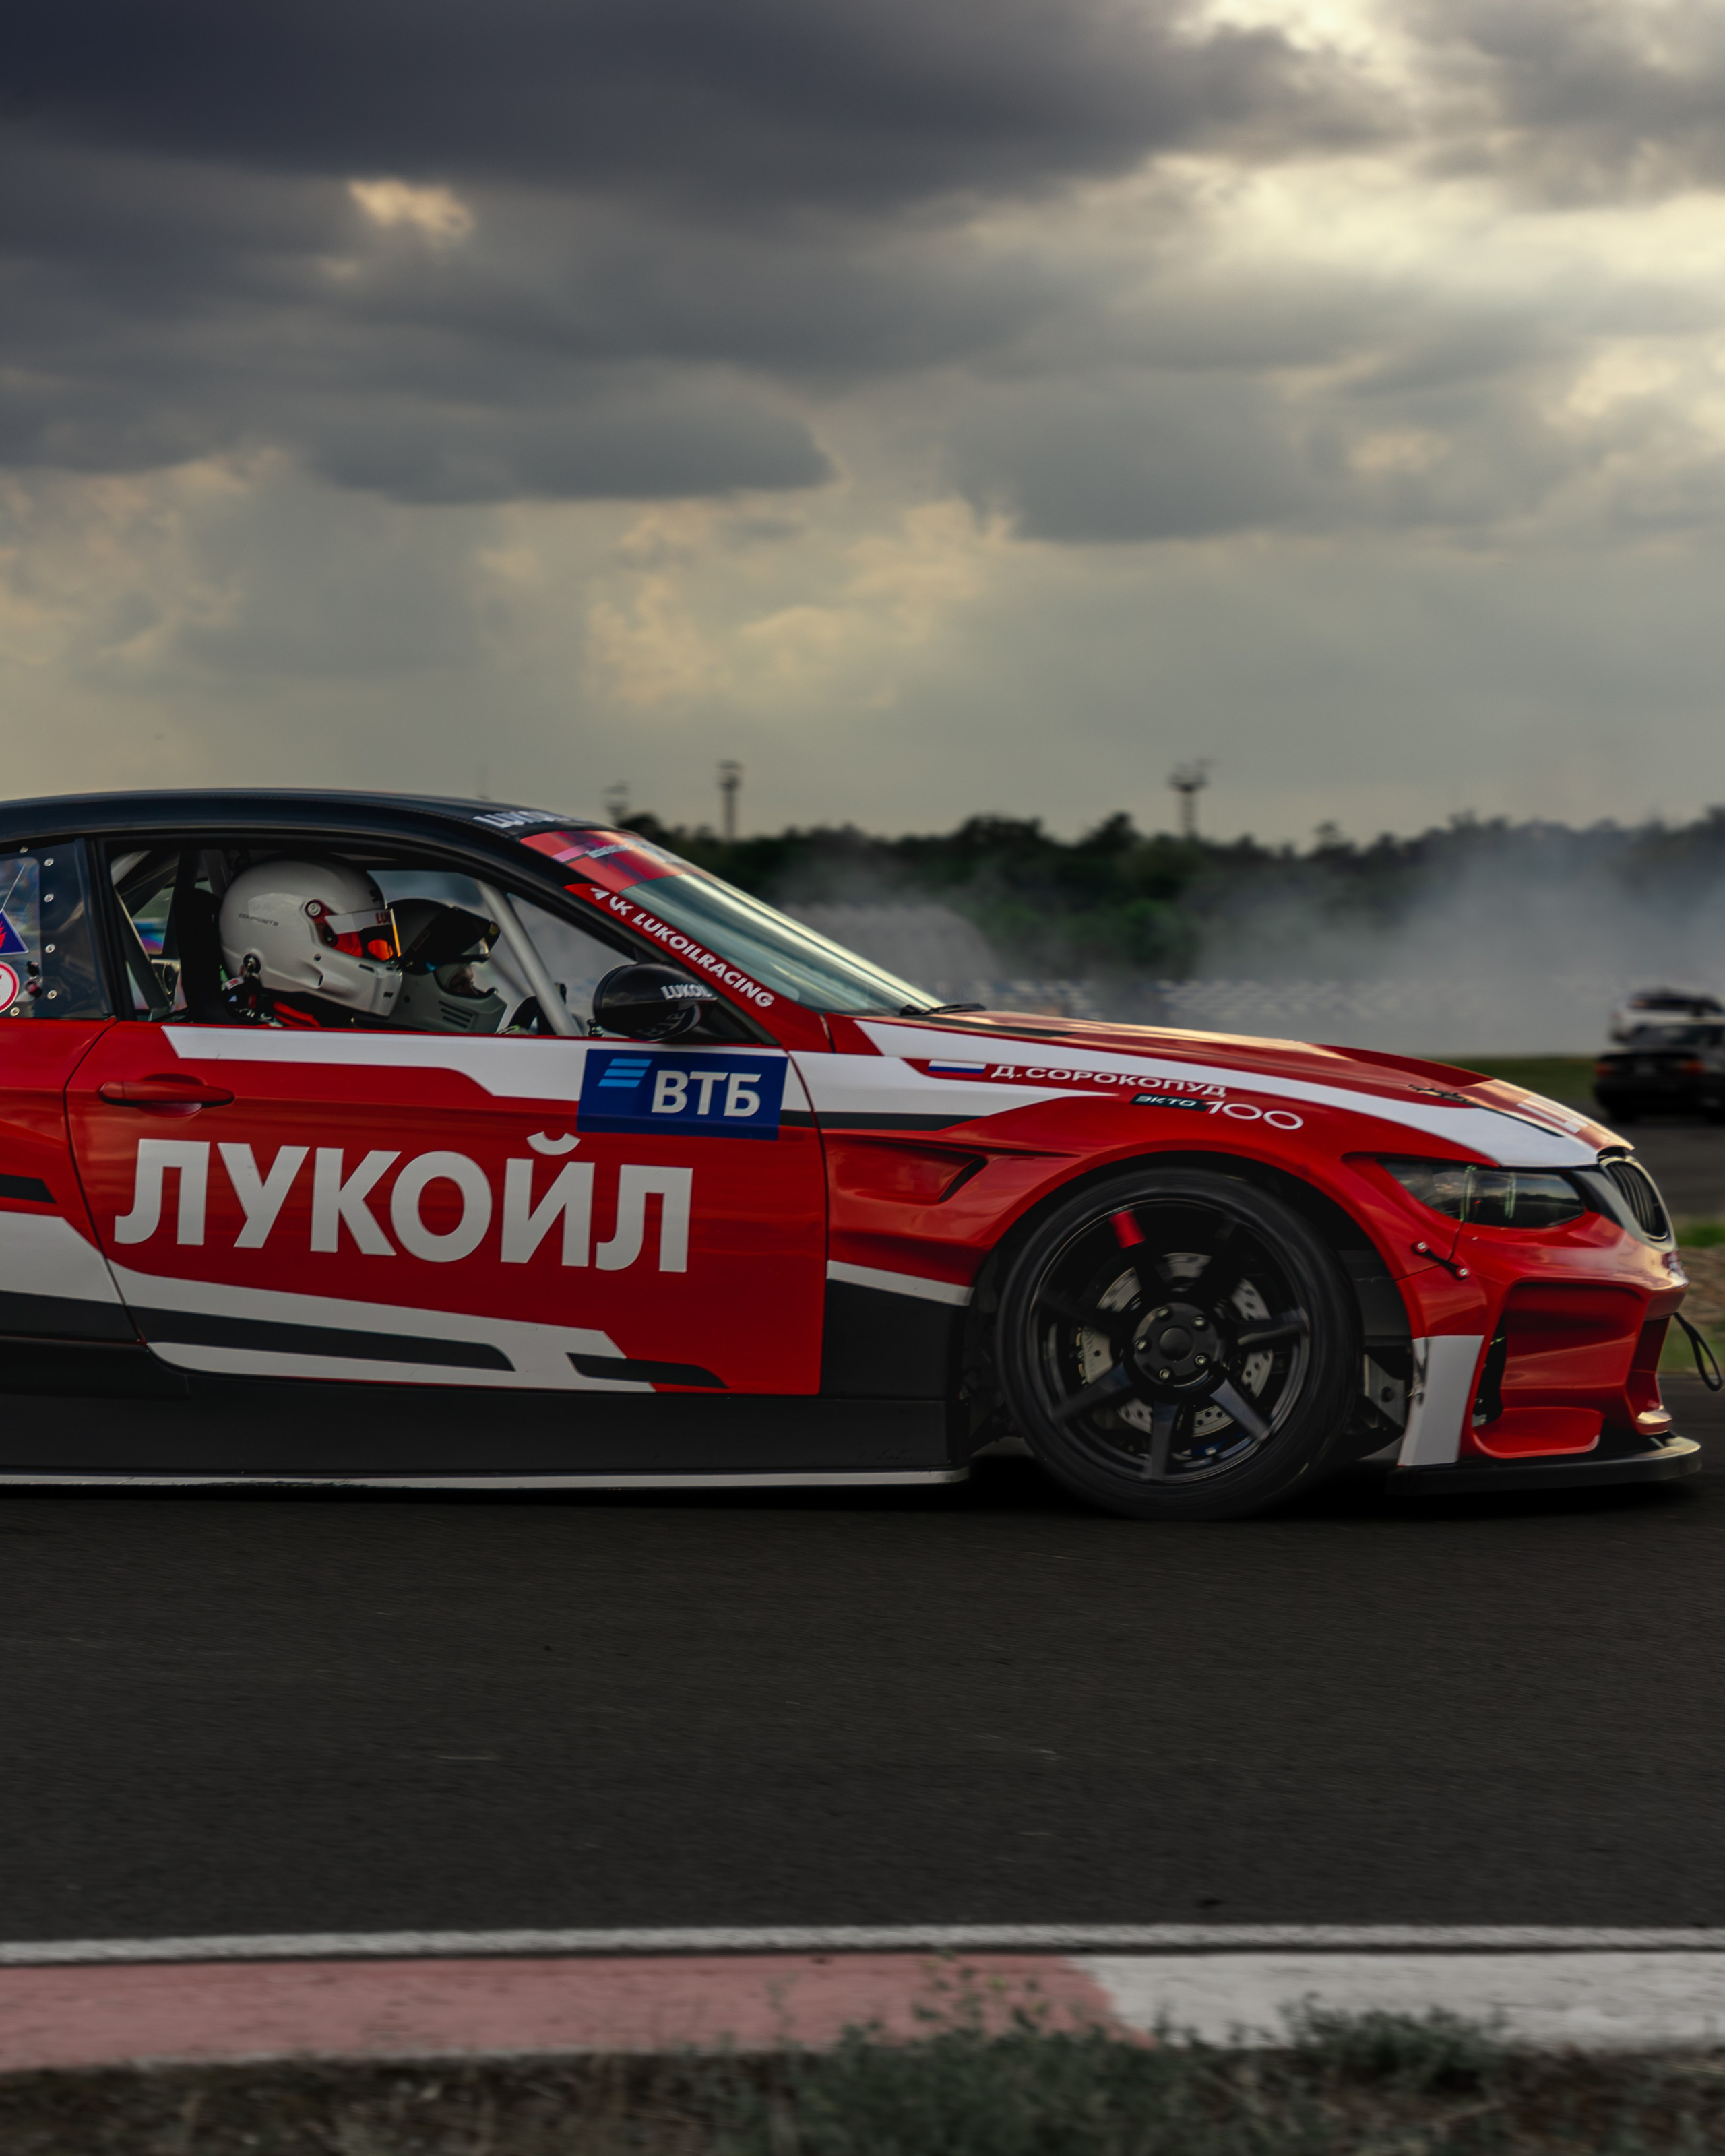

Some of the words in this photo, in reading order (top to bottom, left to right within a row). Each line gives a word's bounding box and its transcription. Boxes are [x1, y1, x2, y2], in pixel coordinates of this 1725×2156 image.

[631, 912, 775, 1008] LUKOILRACING
[660, 983, 713, 1001] LUKOIL
[652, 1070, 762, 1117] ВТБ
[991, 1065, 1227, 1098] Д.СОРОКОПУД
[1135, 1095, 1197, 1107] ЭКТО
[1205, 1100, 1304, 1130] 100
[114, 1131, 693, 1273] ЛУКОЙЛ
